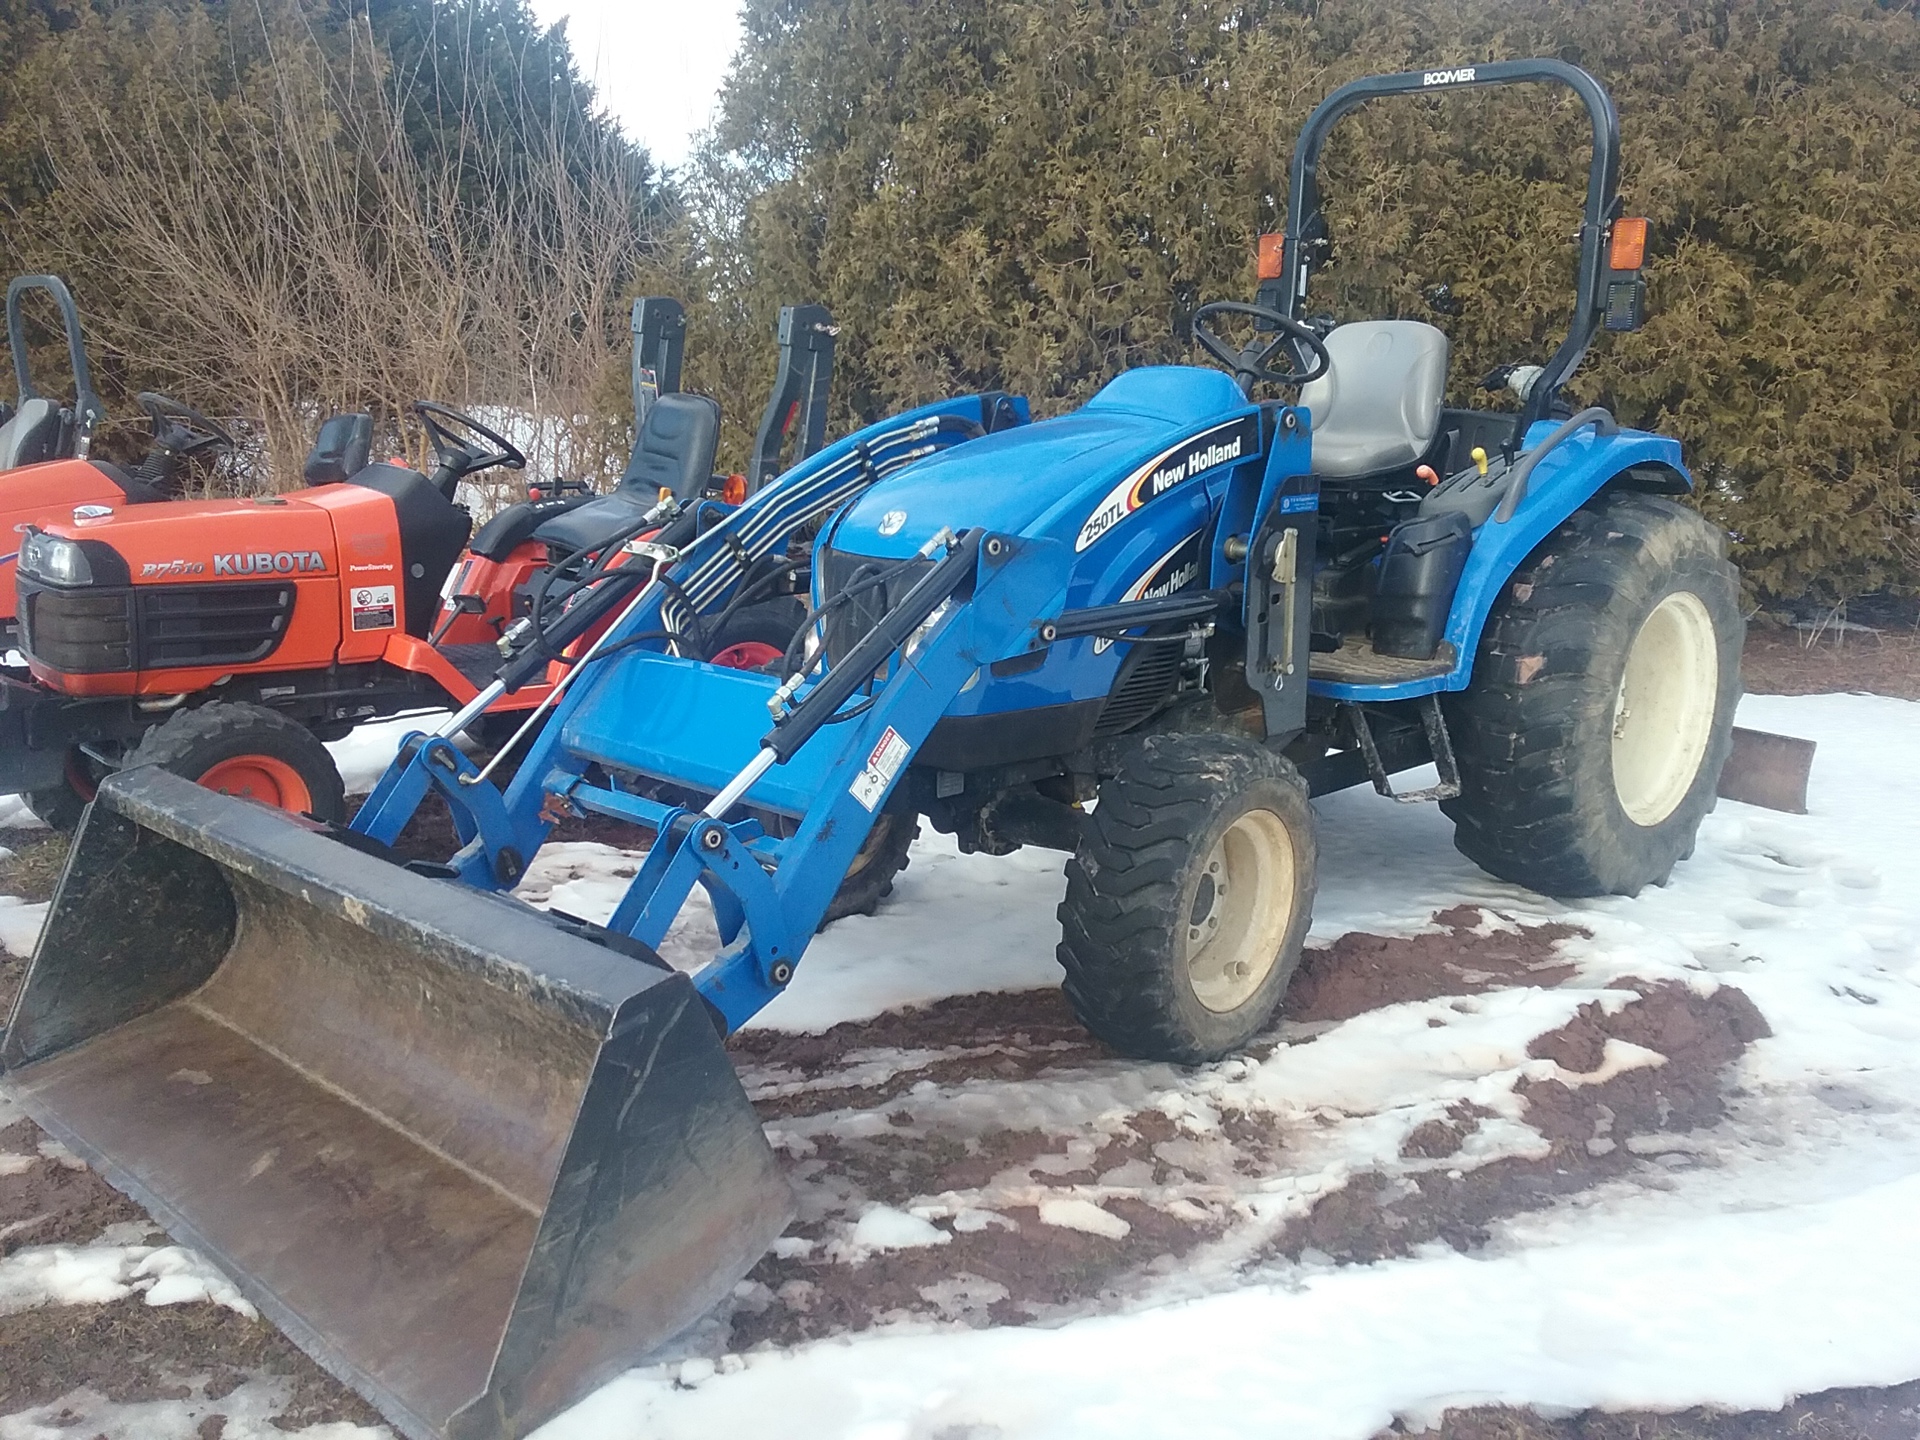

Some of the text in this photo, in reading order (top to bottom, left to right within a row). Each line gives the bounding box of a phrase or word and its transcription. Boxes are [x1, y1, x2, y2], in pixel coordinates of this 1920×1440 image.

[1423, 68, 1476, 86] BOOMER
[1153, 435, 1241, 496] New Holland
[1085, 502, 1124, 543] 250TL
[140, 551, 327, 579] B7510 KUBOTA
[1170, 561, 1199, 594] Holla
[875, 731, 893, 757] DANGER
